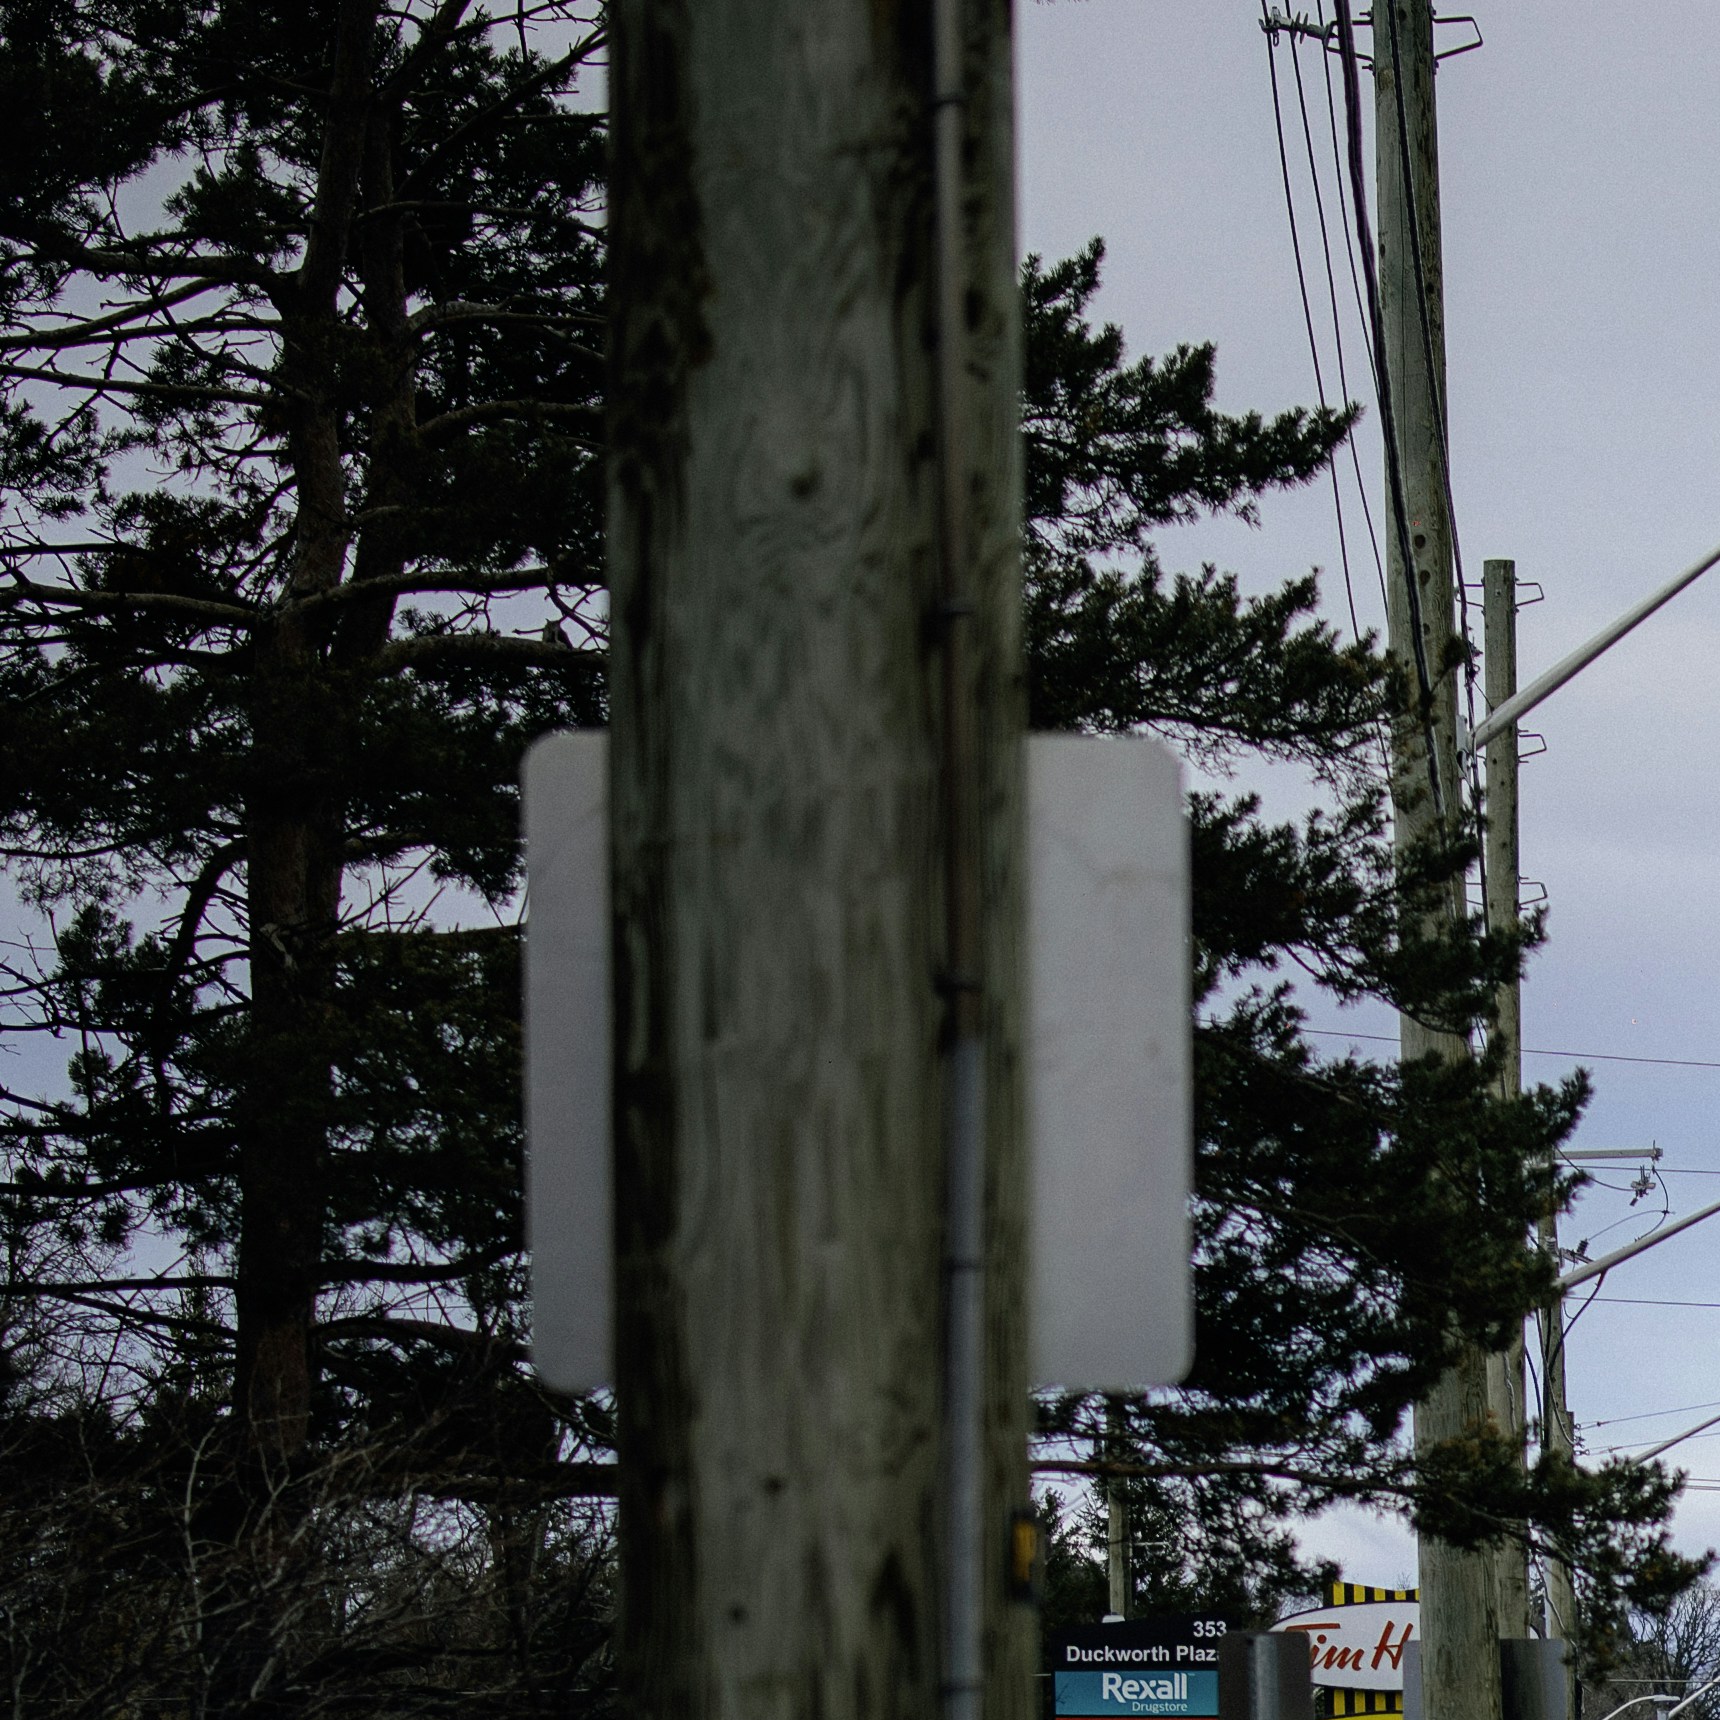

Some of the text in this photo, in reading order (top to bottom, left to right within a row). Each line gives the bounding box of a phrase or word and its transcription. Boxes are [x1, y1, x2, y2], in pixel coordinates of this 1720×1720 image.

[1193, 1621, 1227, 1637] 353
[1066, 1645, 1219, 1662] Duckworth Plaz
[1102, 1672, 1188, 1703] Rexall
[1132, 1701, 1188, 1714] Drugstore
